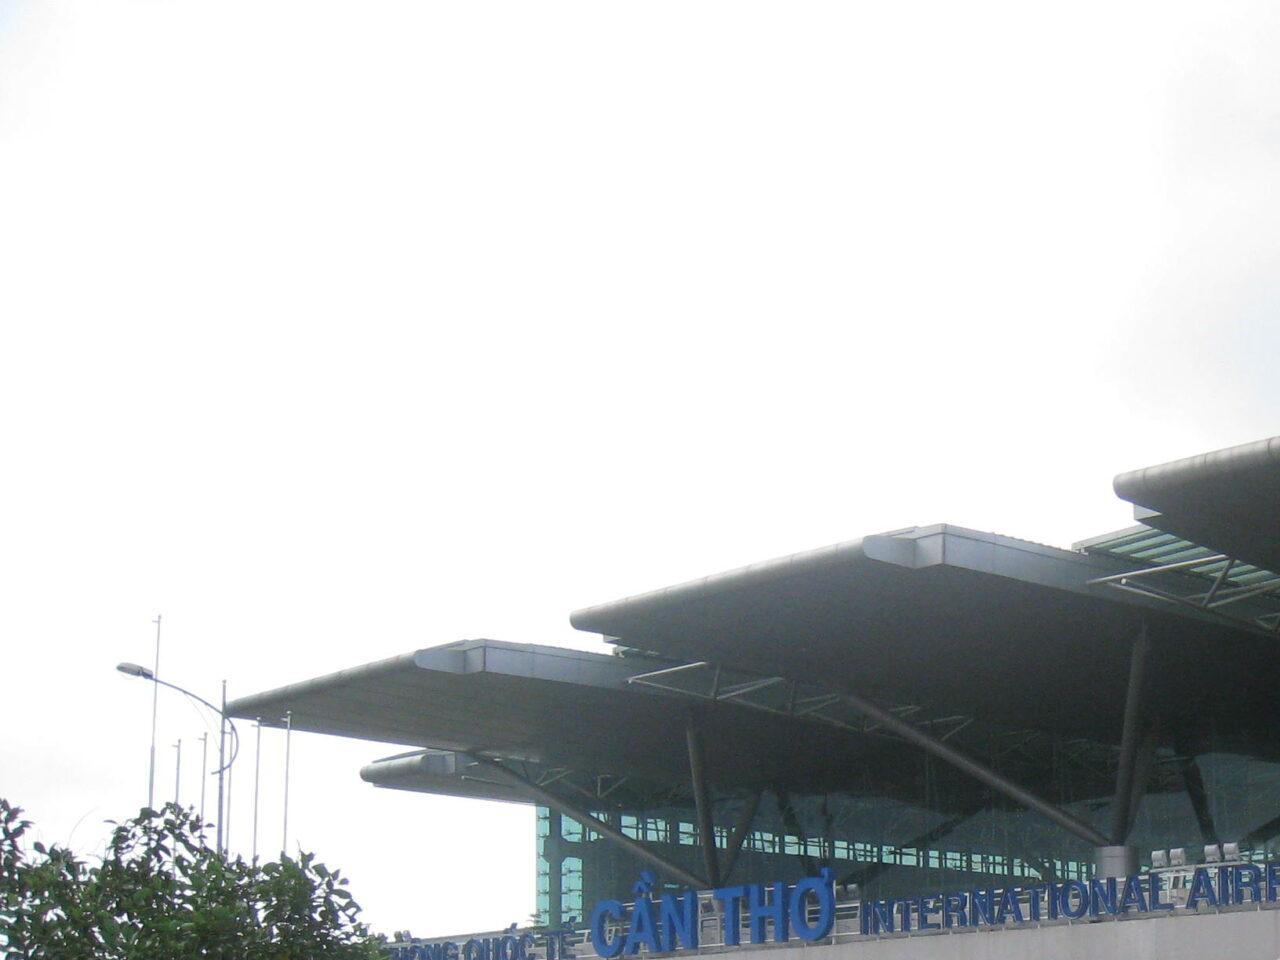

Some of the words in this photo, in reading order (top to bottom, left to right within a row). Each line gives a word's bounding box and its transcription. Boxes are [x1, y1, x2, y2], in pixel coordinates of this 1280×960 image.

[544, 915, 577, 960] TẾ
[591, 870, 700, 959] CẦN
[713, 866, 837, 942] THƠ
[859, 872, 1175, 936] INTERNATIONAL
